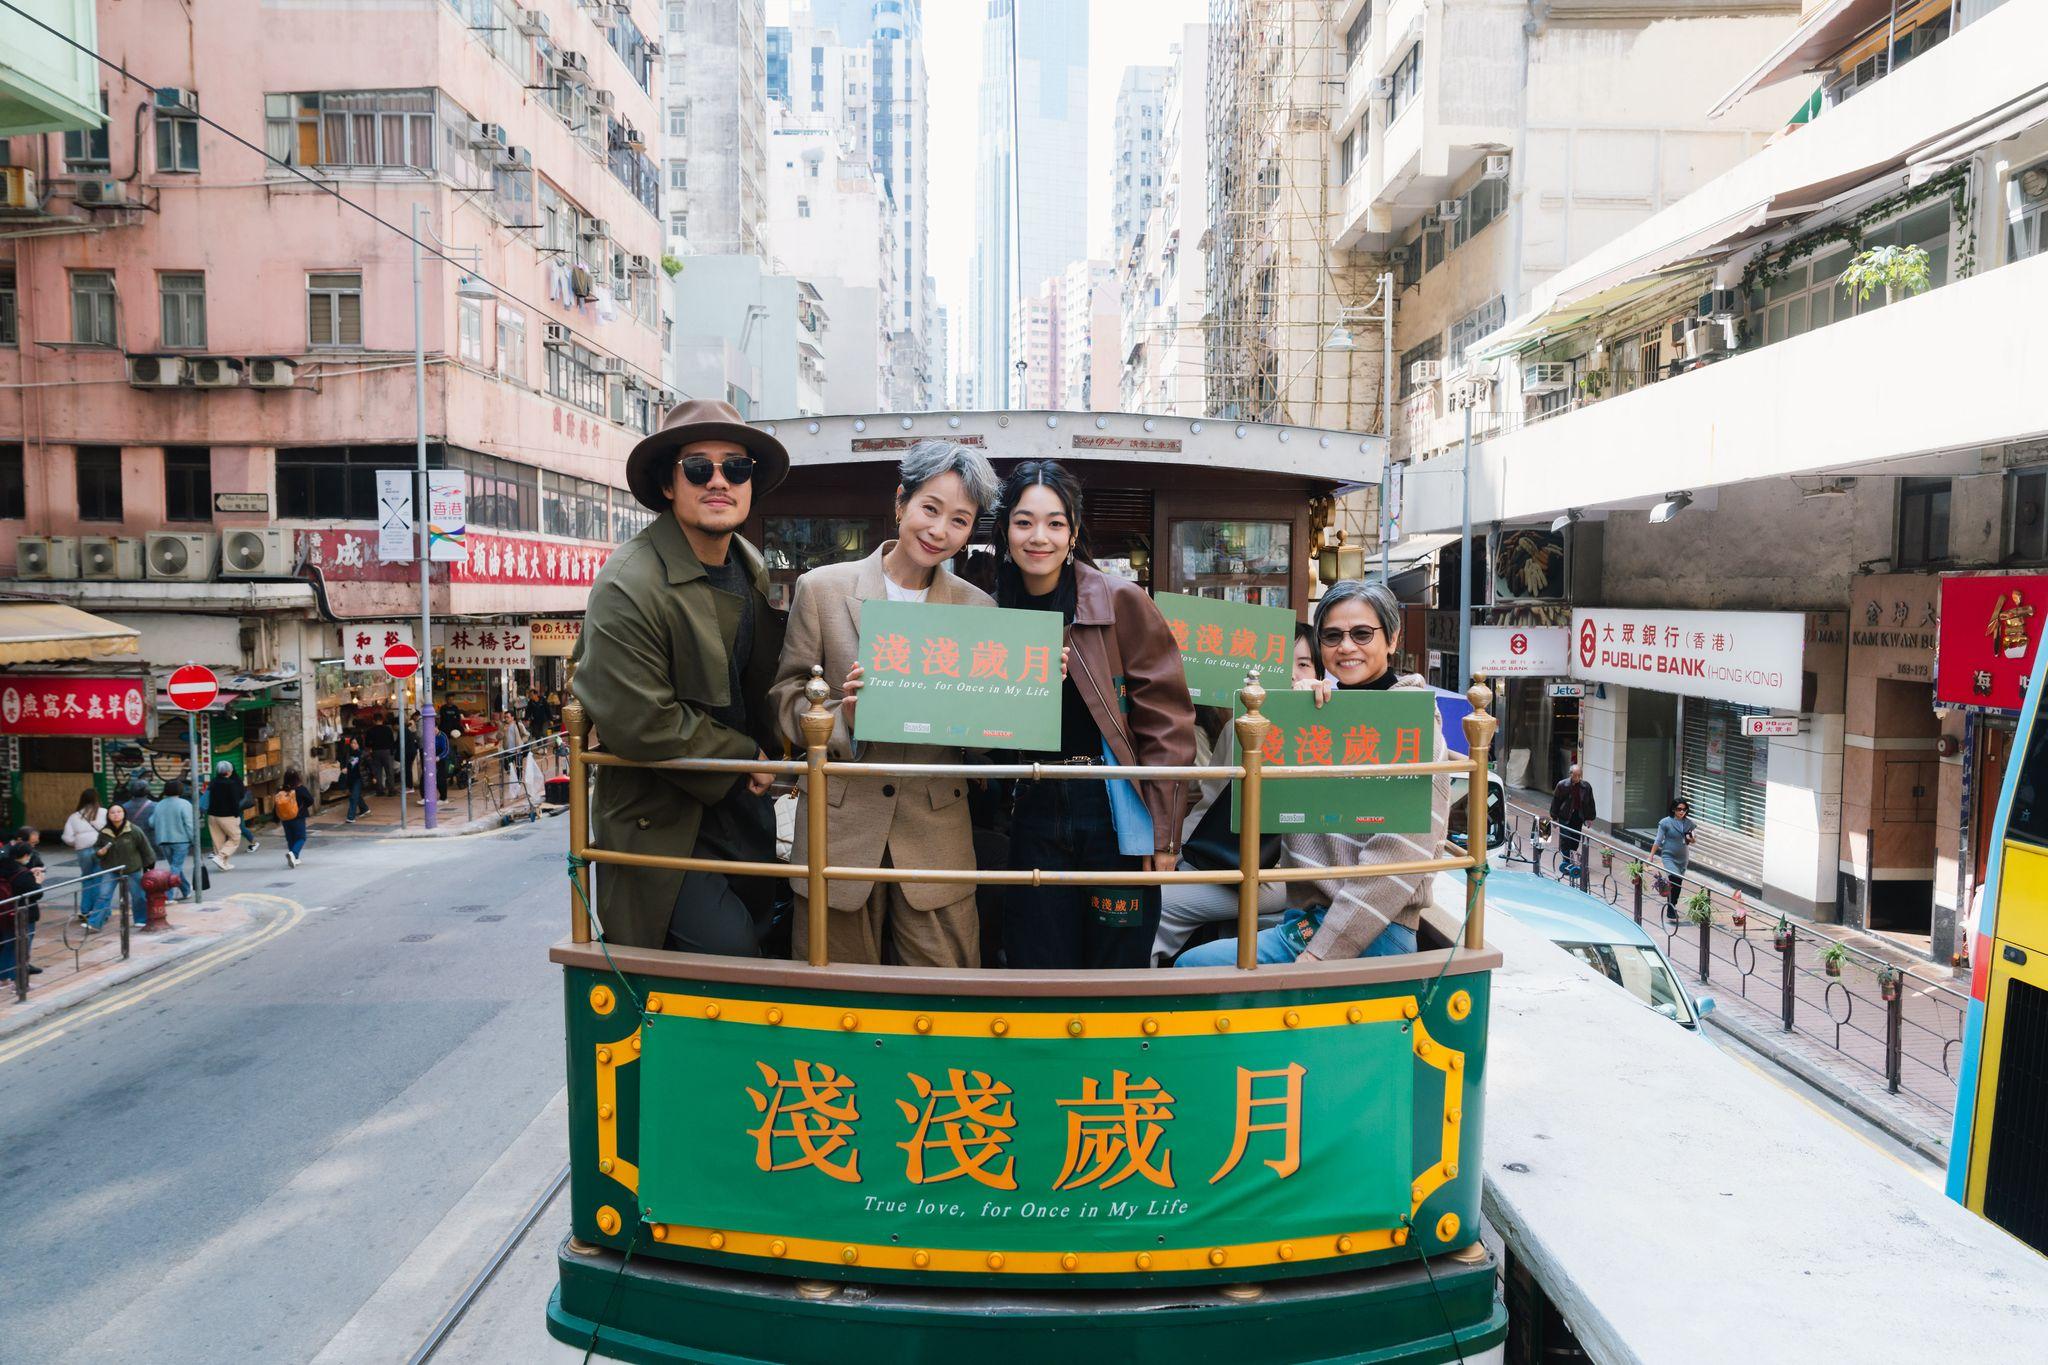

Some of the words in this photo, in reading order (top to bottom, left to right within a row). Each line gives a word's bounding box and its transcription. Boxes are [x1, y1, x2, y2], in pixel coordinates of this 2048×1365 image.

[450, 631, 525, 651] 林橋記
[1853, 631, 1879, 646] KAM
[1881, 632, 1918, 648] KWAN
[871, 633, 1050, 684] 淺淺歲月
[1205, 657, 1218, 666] for
[1220, 659, 1240, 668] Once
[1242, 662, 1251, 670] in
[1253, 663, 1266, 673] My
[1268, 665, 1285, 674] Life
[1601, 650, 1653, 673] PUBLIC
[1657, 655, 1705, 678] BANK
[1707, 664, 1742, 683] (HONG
[1745, 670, 1783, 689] KONG)
[869, 676, 895, 688] True
[899, 678, 927, 691] love,
[935, 680, 953, 692] for
[957, 682, 984, 693] Once
[989, 684, 1000, 694] in
[1004, 685, 1022, 698] My
[1026, 686, 1050, 697] Life
[22, 693, 123, 719] 燕窩冬蟲草
[744, 1057, 1308, 1192] 淺淺歲月
[863, 1196, 907, 1214] True
[916, 1198, 967, 1219] love,
[980, 1202, 1012, 1218] for
[1020, 1202, 1069, 1218] Once
[1080, 1203, 1099, 1218] in
[1107, 1200, 1139, 1221] My
[1146, 1197, 1189, 1216] Life
